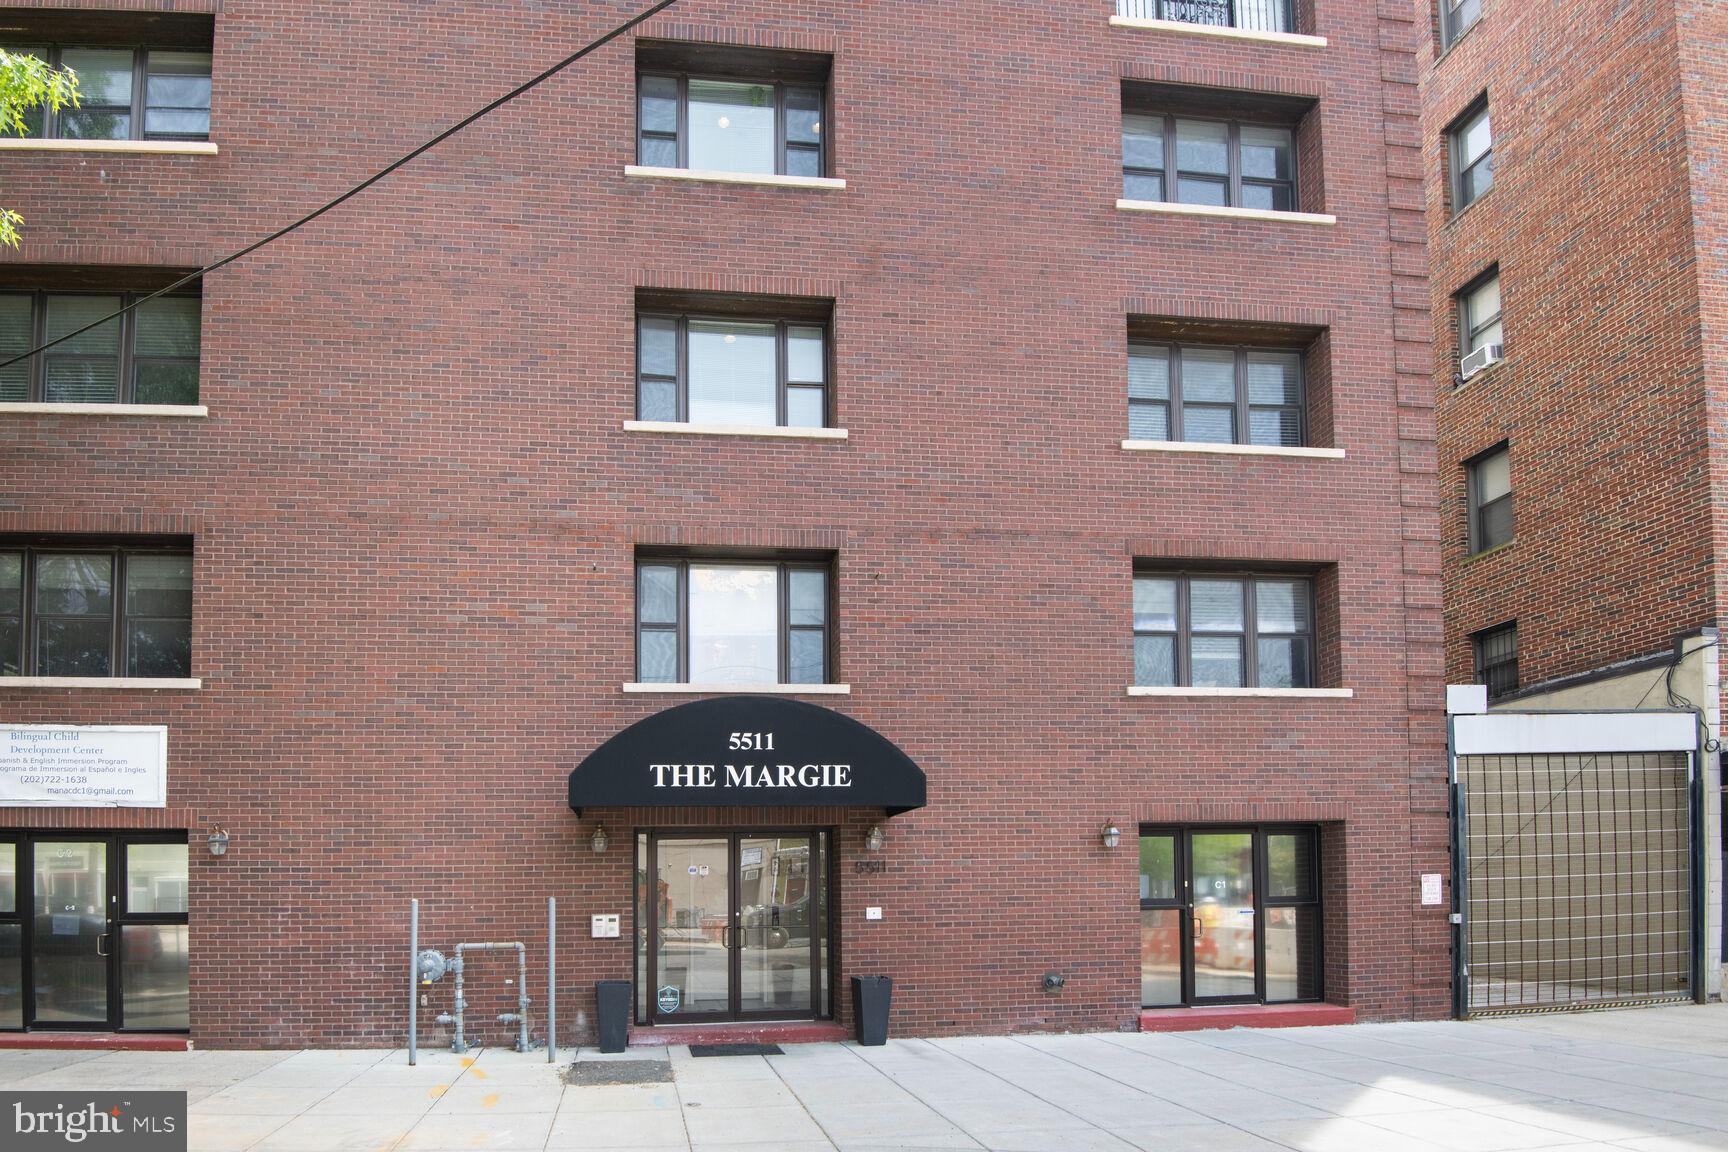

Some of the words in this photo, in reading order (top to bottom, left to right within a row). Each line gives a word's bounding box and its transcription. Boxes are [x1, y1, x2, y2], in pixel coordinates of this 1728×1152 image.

[10, 731, 51, 742] Bilingual
[54, 731, 79, 741] Child
[729, 732, 775, 750] 5511
[10, 745, 70, 756] Development
[73, 746, 104, 755] Center
[20, 775, 88, 784] (202)722-1638
[649, 764, 716, 787] THE
[724, 764, 852, 787] MARGIE
[1214, 880, 1226, 888] C1
